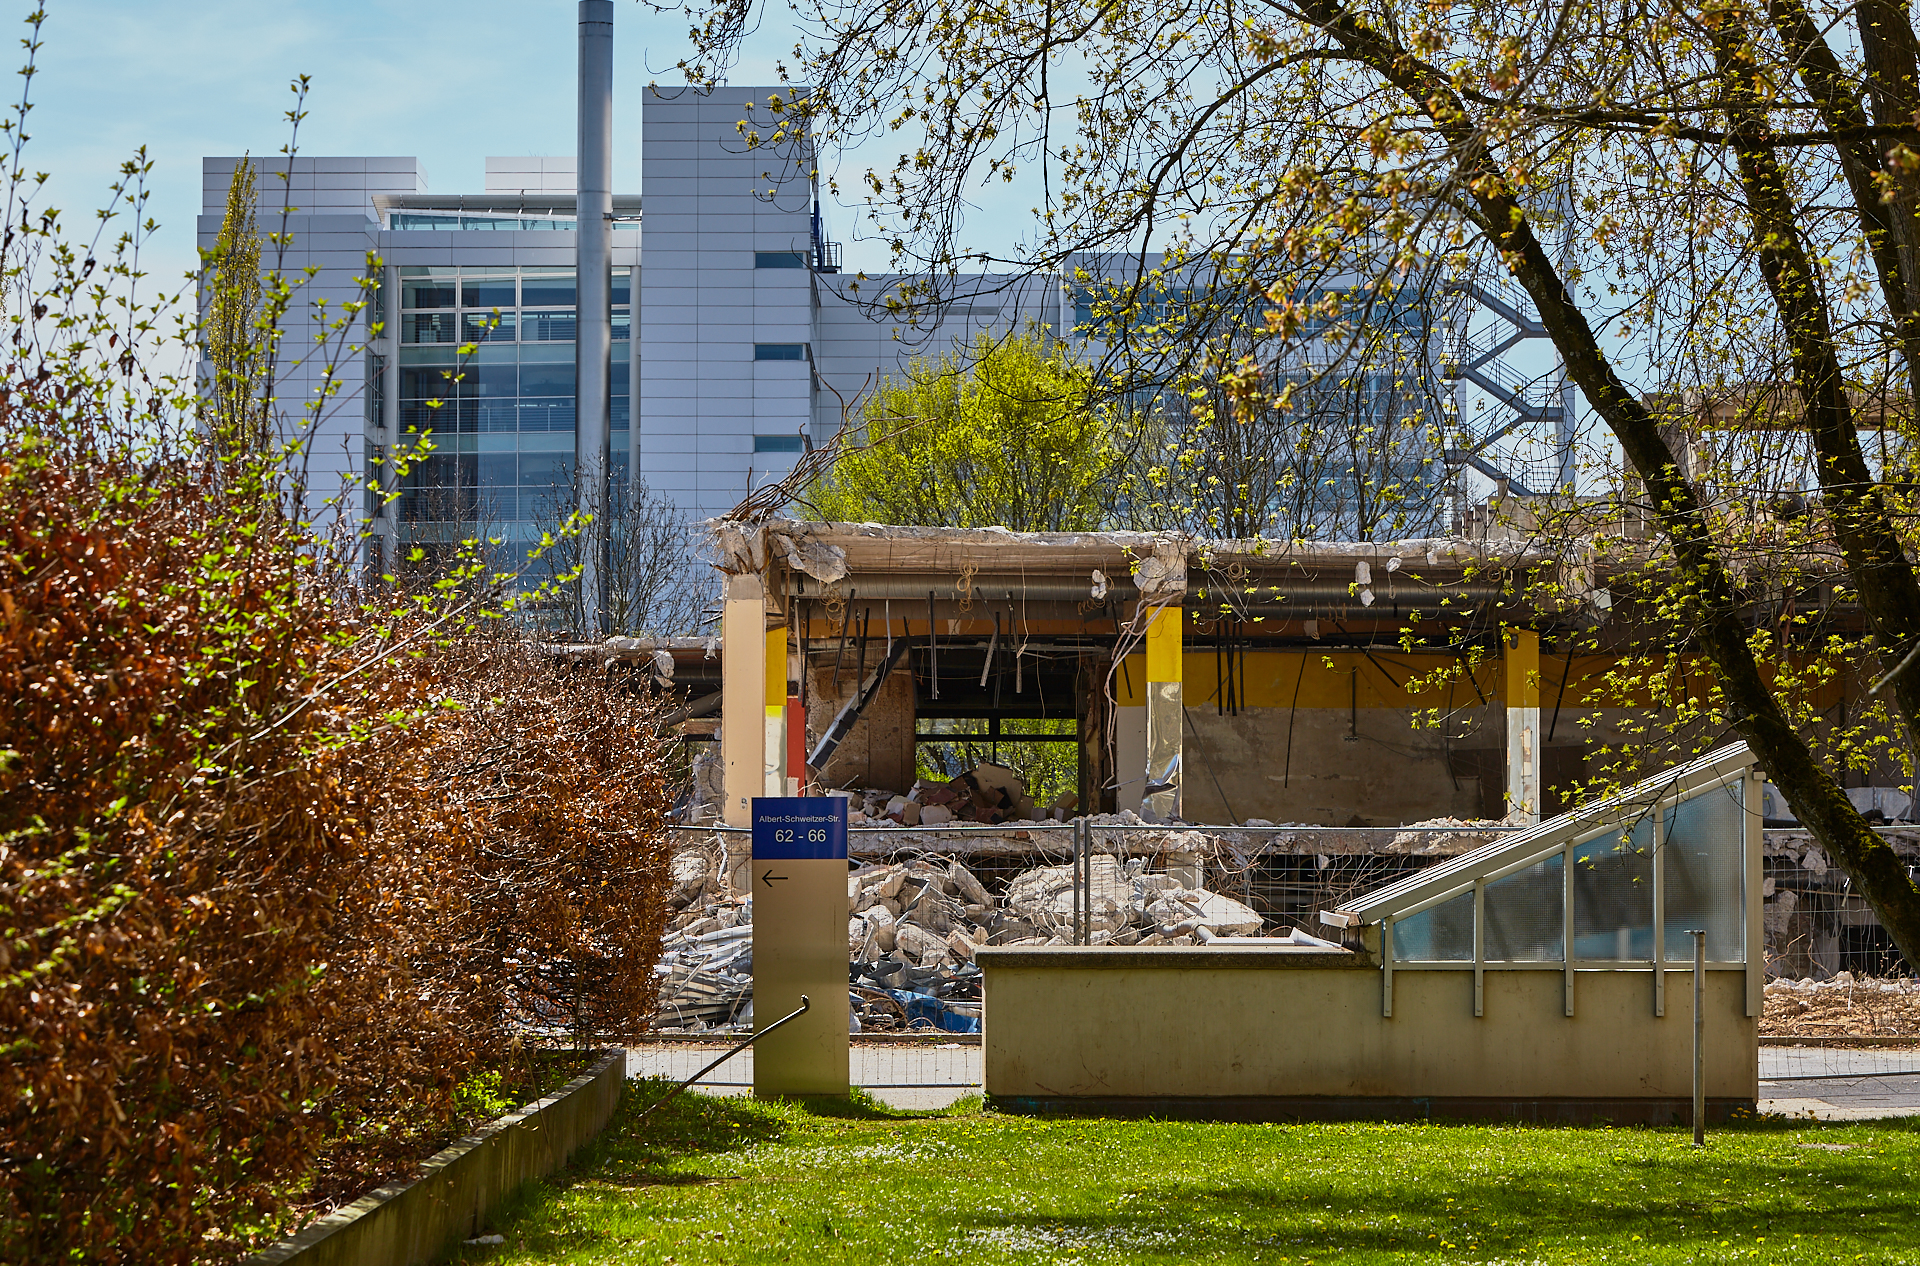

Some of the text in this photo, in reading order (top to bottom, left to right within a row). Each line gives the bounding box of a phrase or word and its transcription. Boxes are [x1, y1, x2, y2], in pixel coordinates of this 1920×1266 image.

[759, 815, 841, 823] Albert-Schweitzer-Str.
[775, 829, 794, 843] 62
[808, 829, 826, 843] 66
